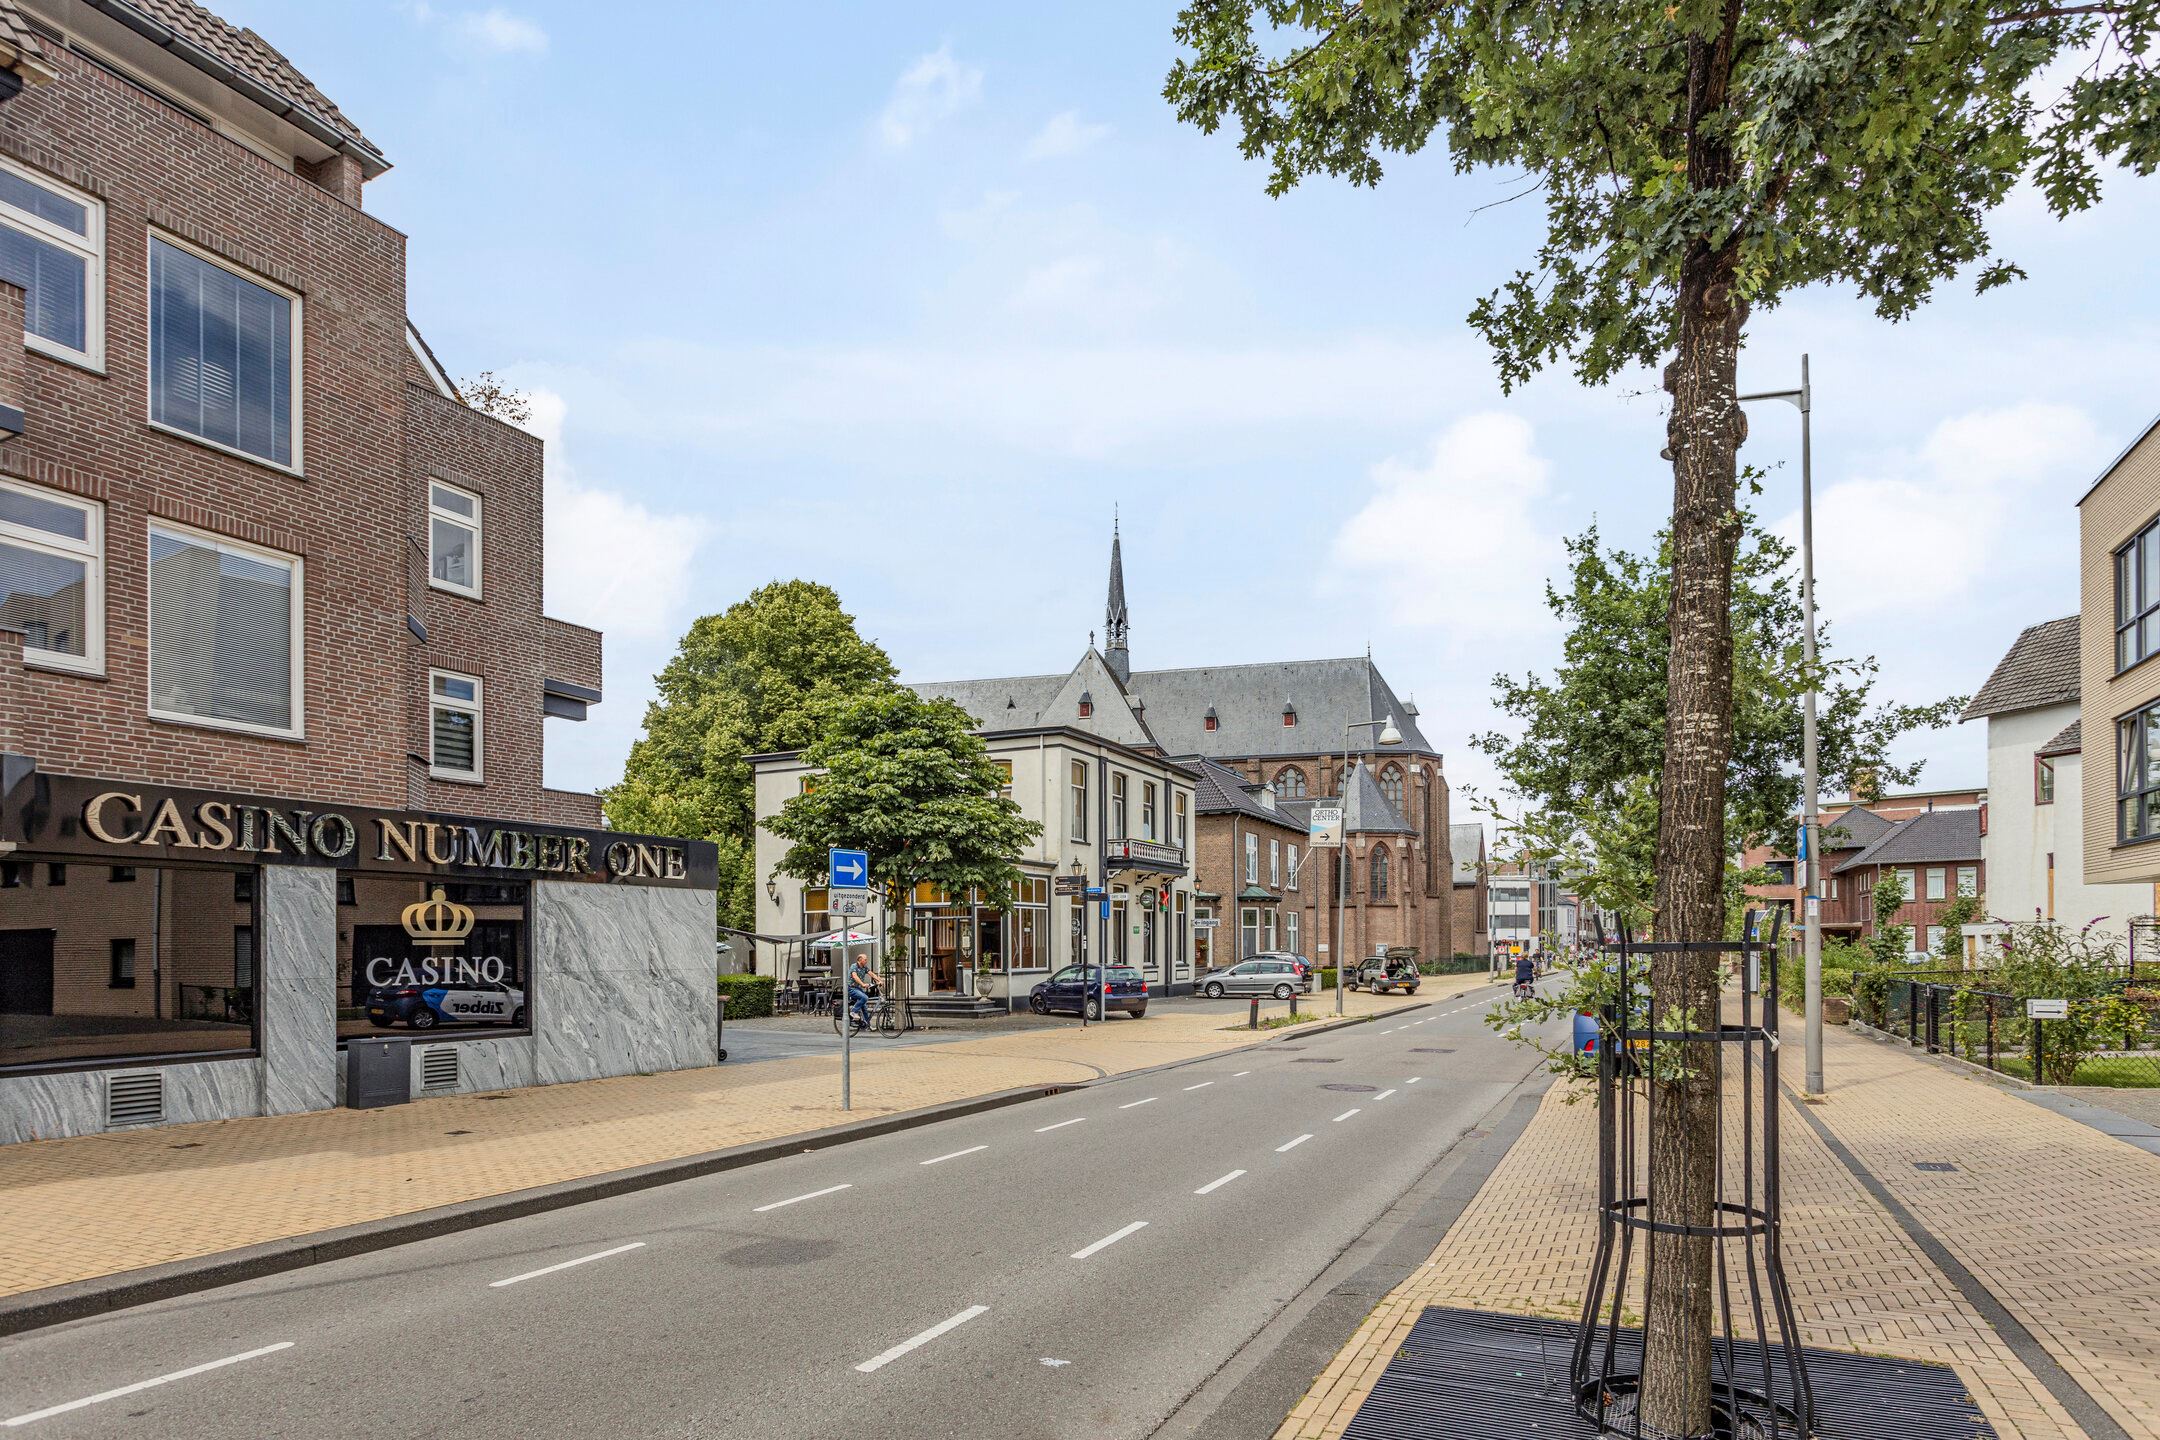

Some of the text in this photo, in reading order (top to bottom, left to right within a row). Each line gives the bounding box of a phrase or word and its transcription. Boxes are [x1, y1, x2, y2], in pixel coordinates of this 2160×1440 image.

[83, 791, 688, 879] CASINO NUMBER ONE
[1200, 919, 1219, 927] ingang
[366, 955, 504, 987] CASINO
